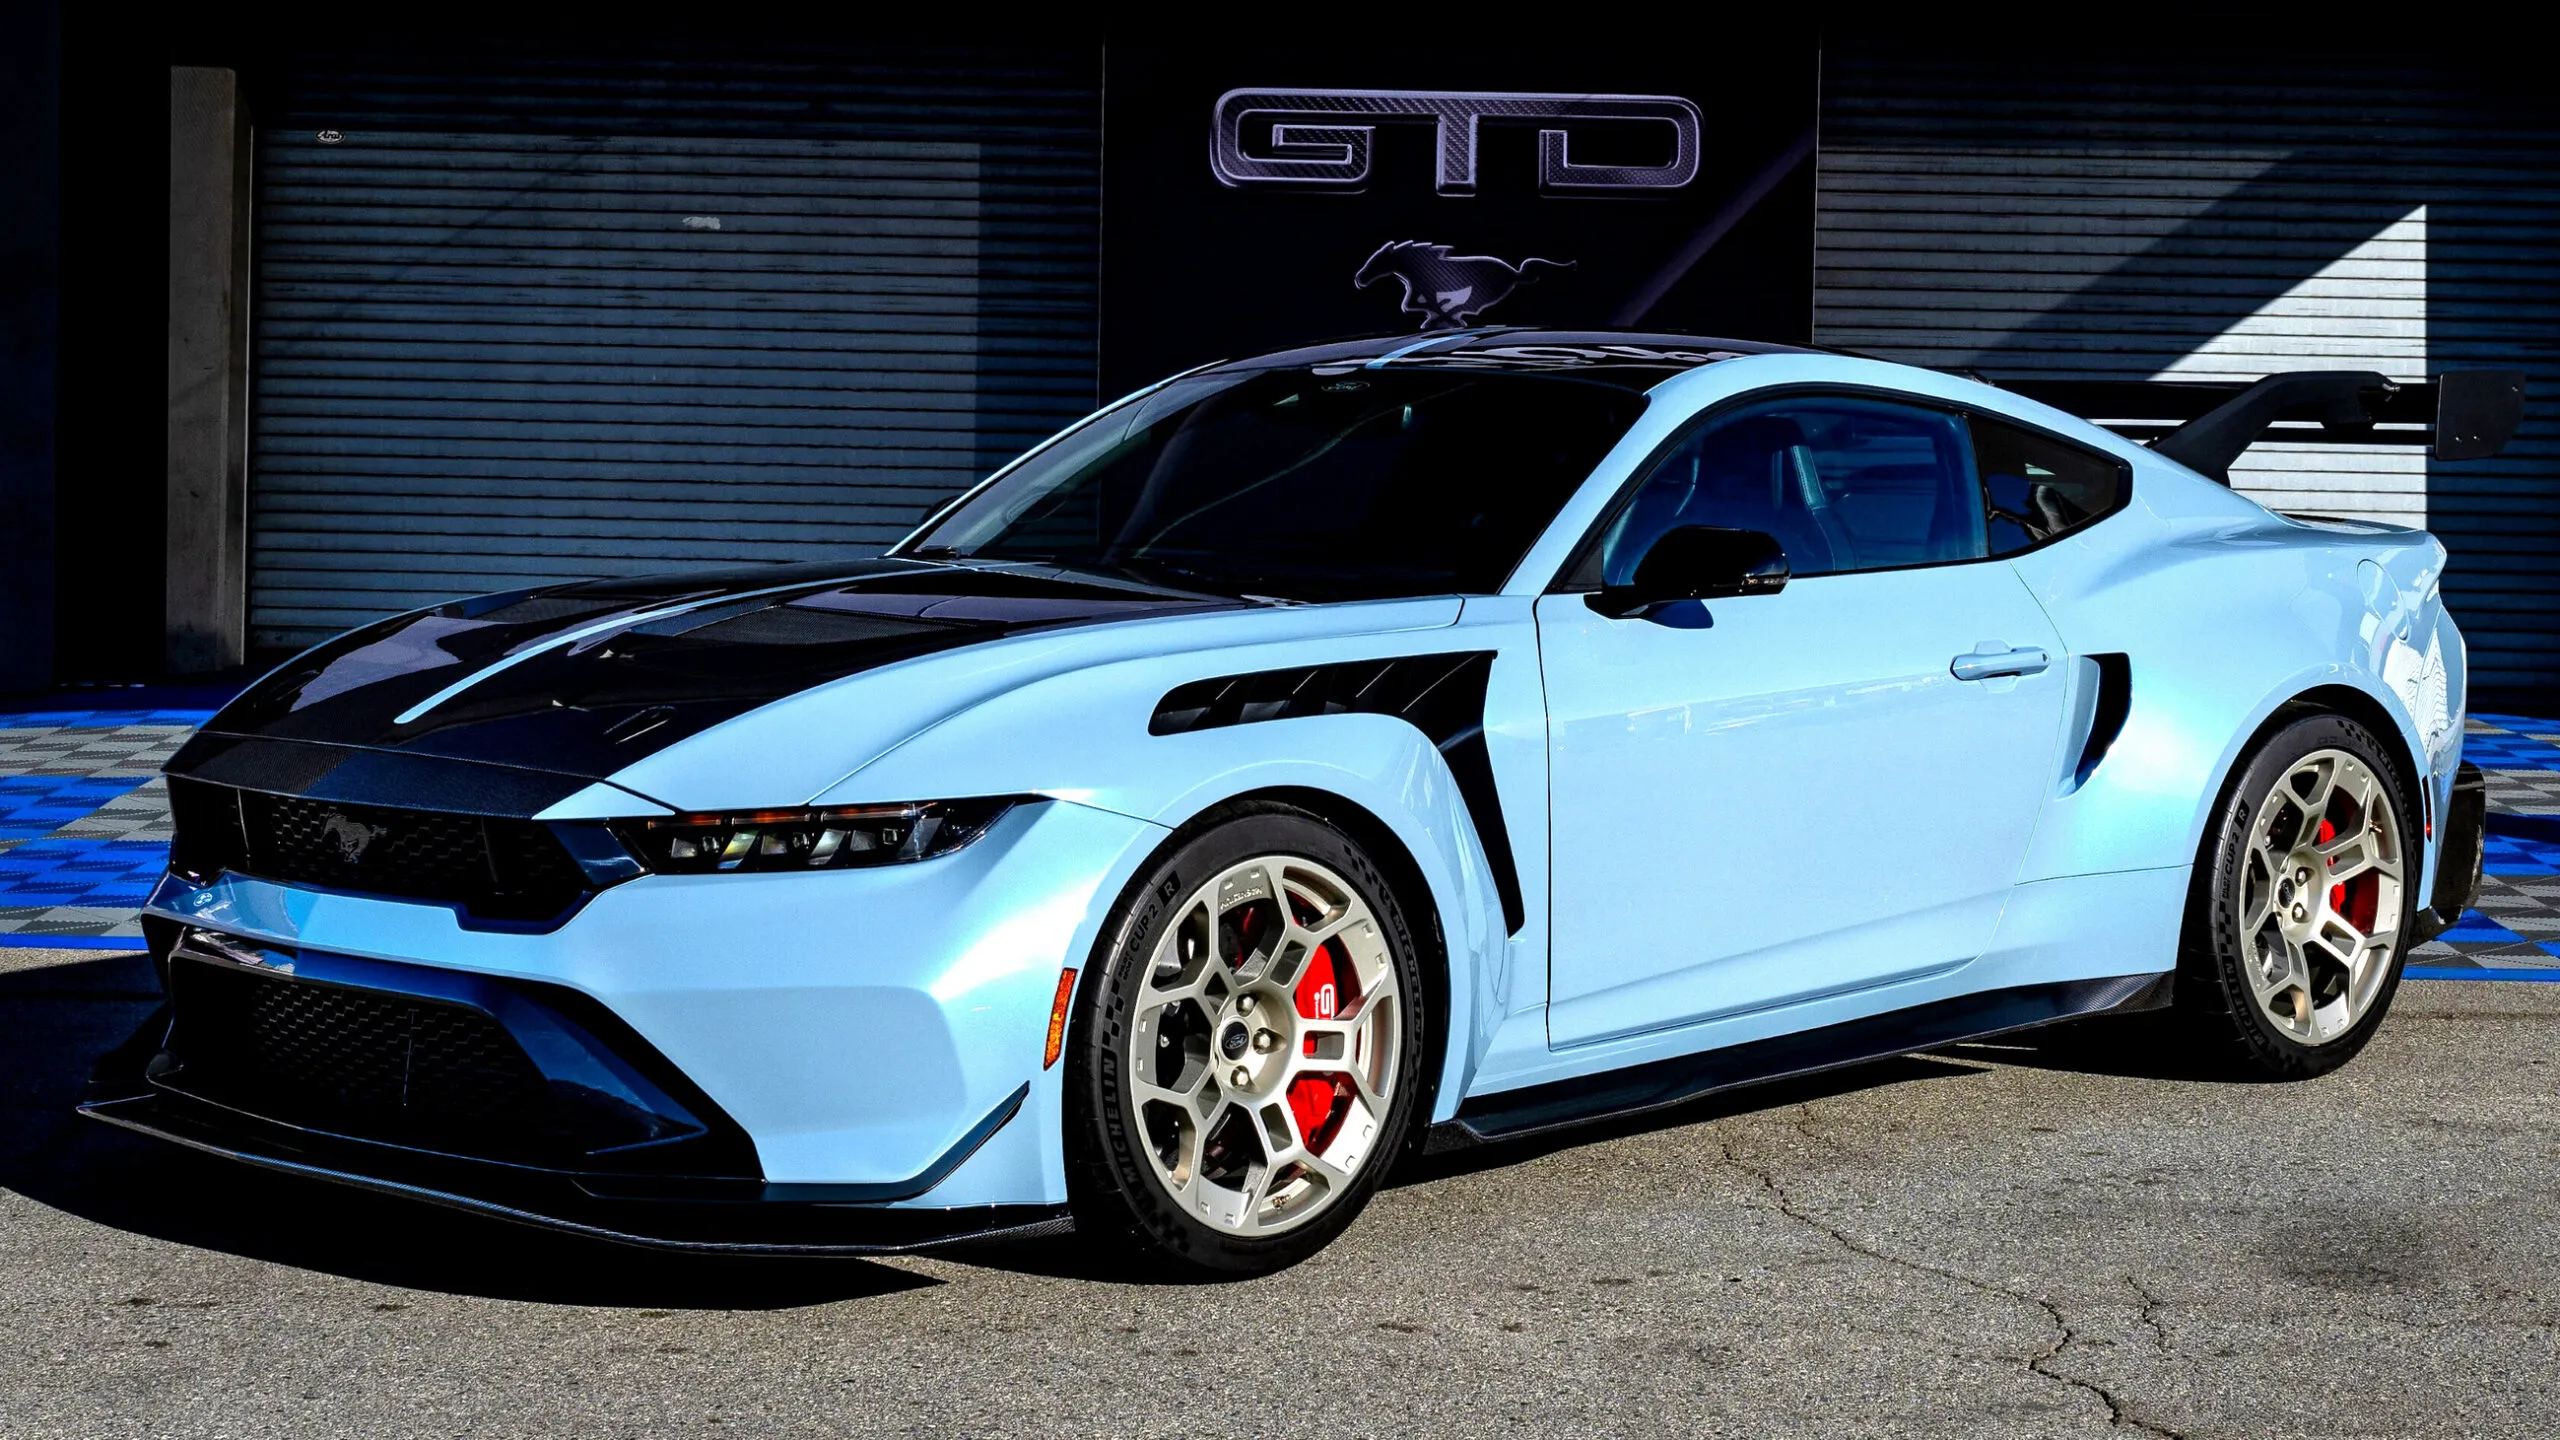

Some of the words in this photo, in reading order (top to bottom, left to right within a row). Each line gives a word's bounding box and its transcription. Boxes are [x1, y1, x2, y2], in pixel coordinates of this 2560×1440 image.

[1209, 87, 1704, 197] GTD
[2224, 842, 2238, 875] CUP
[1130, 914, 1150, 952] CUP
[1148, 903, 1159, 919] 2
[1163, 880, 1176, 897] R
[2224, 961, 2266, 1046] MICHELIN
[1102, 1056, 1141, 1185] MICHELIN
